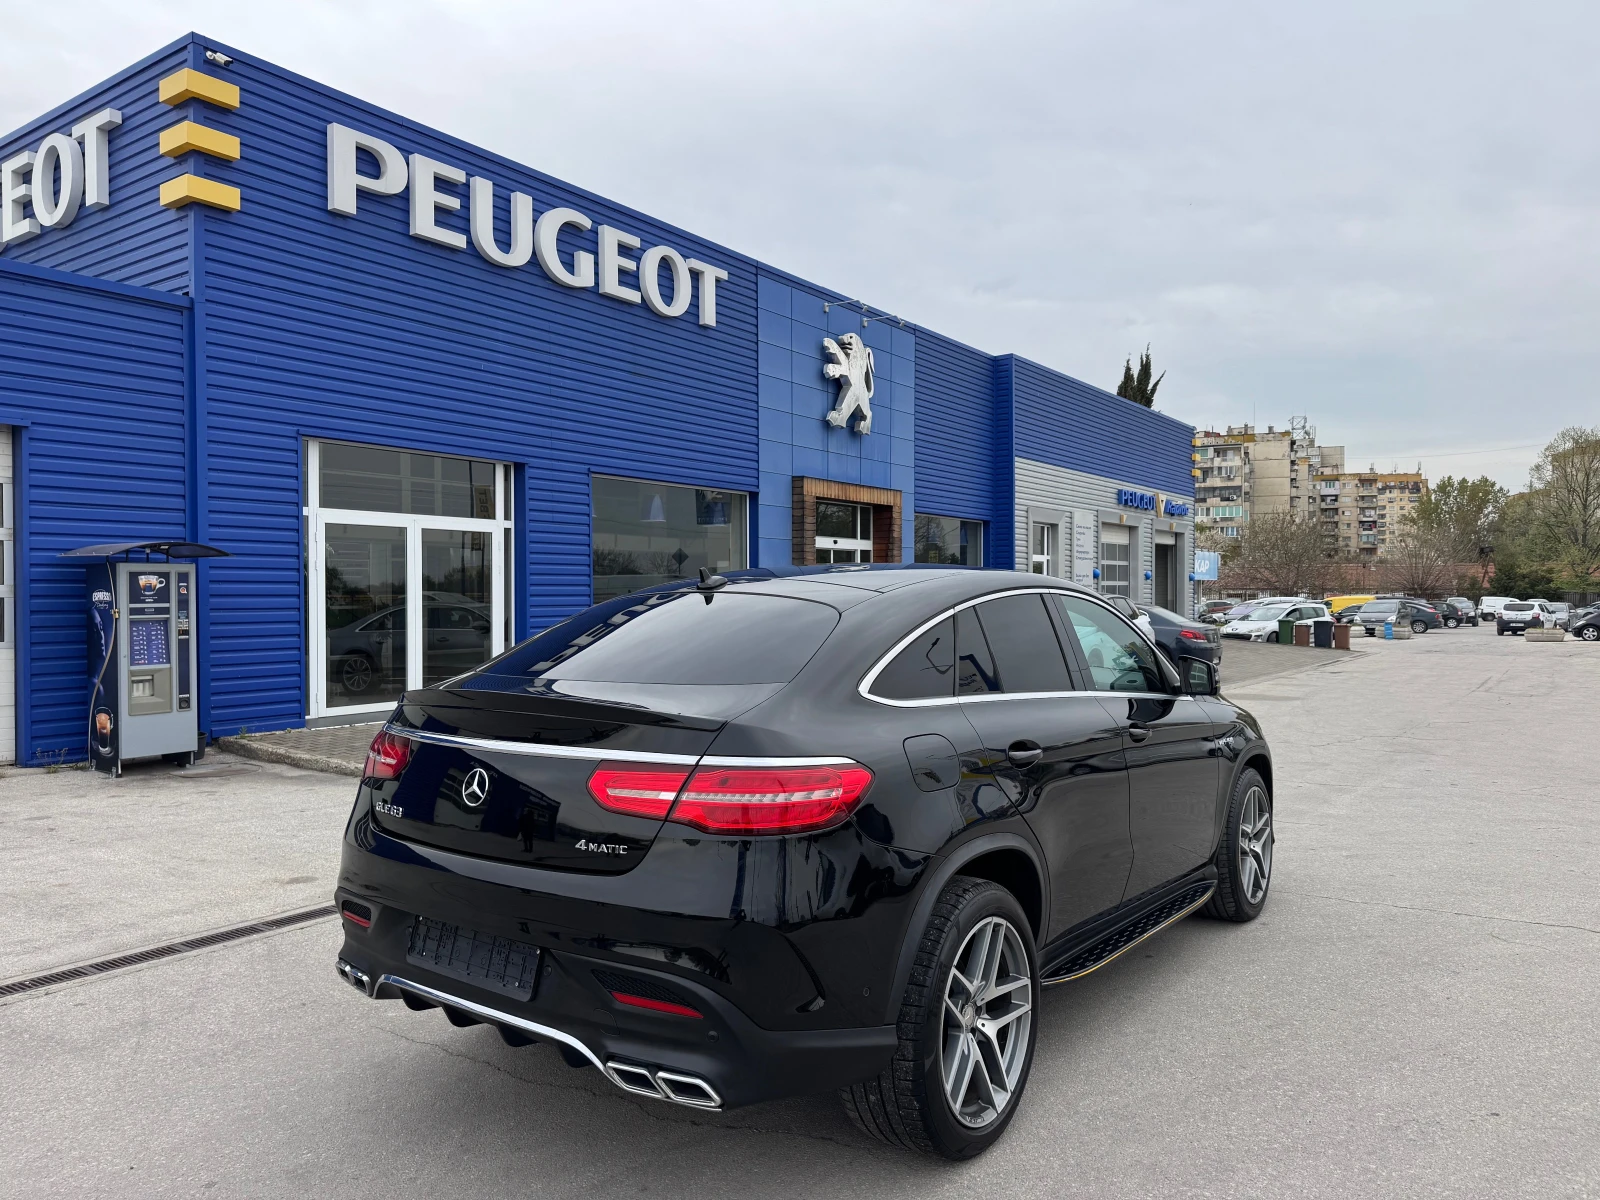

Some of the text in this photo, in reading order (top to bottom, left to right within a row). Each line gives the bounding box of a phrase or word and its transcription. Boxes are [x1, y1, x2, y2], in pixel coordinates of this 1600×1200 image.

[0, 107, 123, 251] EOT
[327, 122, 729, 328] PEUGEOT
[1118, 489, 1157, 511] PEUGEOT
[574, 839, 628, 855] 4MATIC
